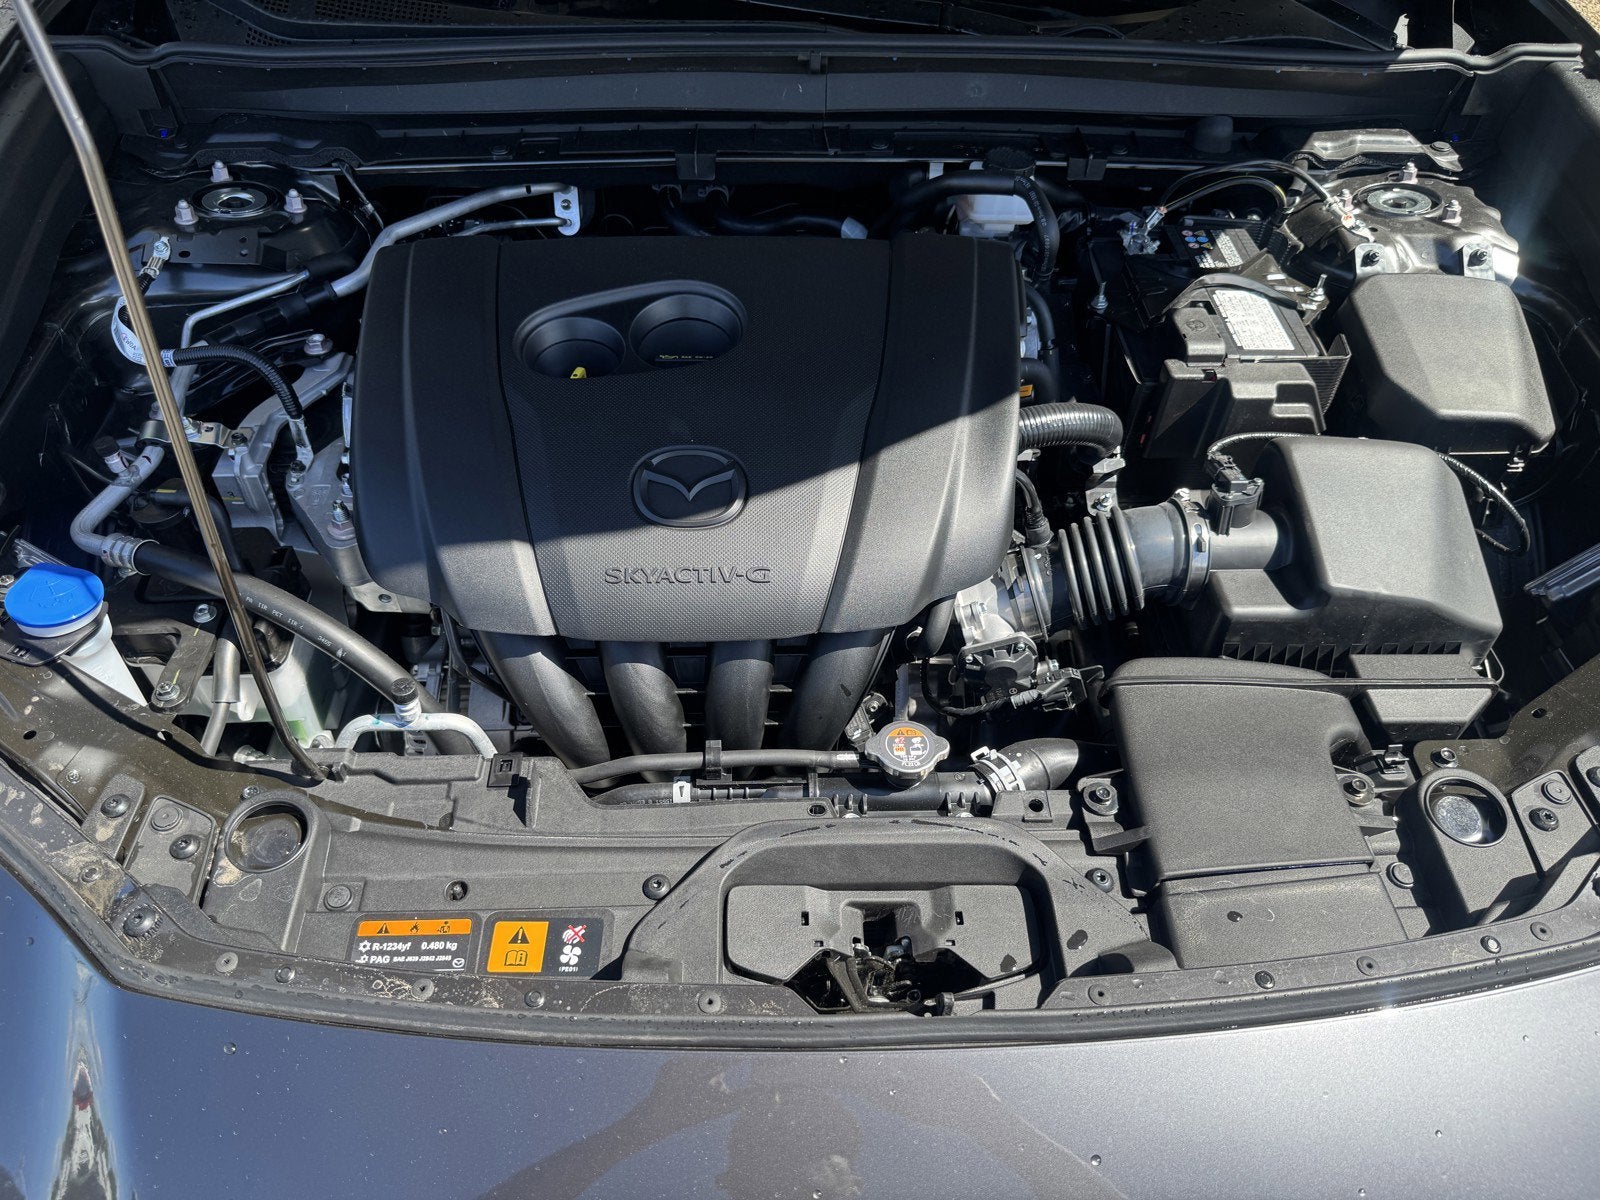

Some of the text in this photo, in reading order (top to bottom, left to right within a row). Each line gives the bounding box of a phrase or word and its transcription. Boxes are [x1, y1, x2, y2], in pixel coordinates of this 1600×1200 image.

[604, 566, 771, 585] SKYACTIV-G
[372, 941, 458, 952] R-1234yf 0.480 kg
[369, 955, 391, 964] PAG
